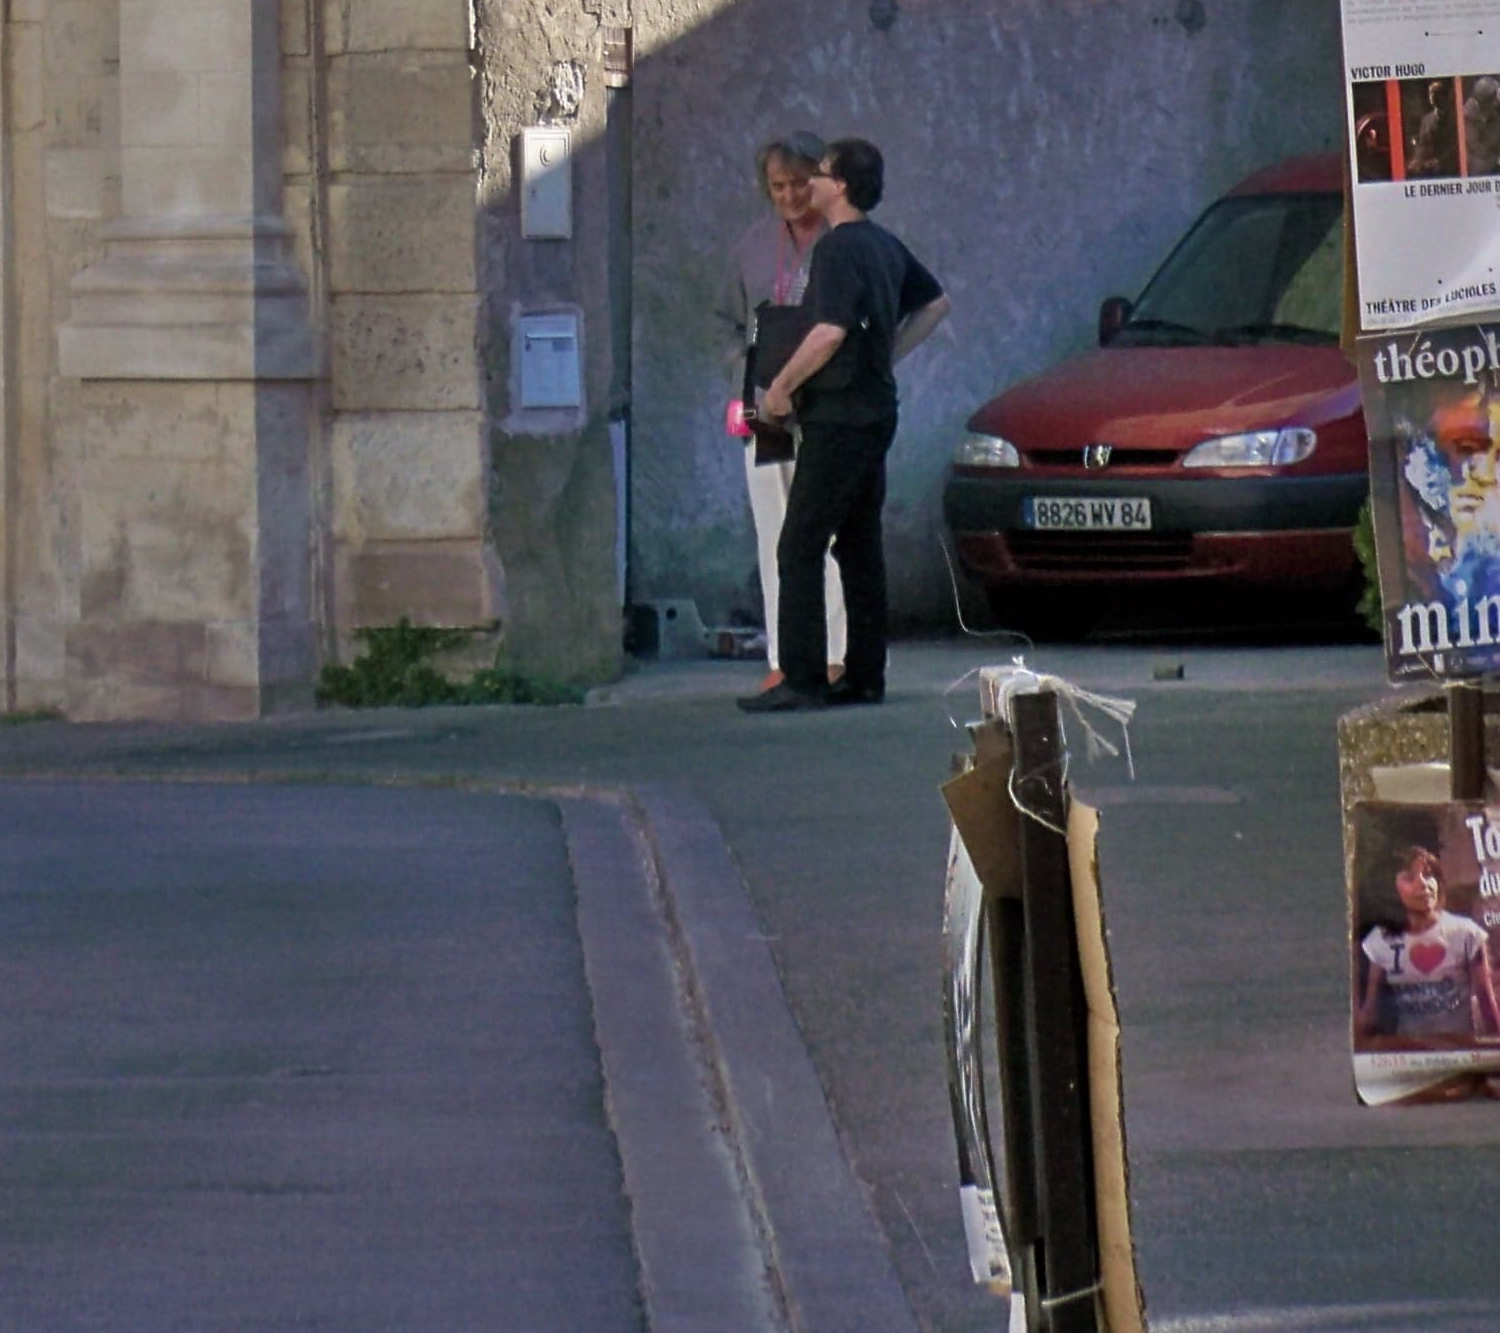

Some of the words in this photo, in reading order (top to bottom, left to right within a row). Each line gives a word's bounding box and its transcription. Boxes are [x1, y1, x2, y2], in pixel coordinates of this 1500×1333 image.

[1350, 64, 1392, 80] VICTOR
[1395, 63, 1426, 77] HUGO
[1404, 185, 1417, 198] LE
[1420, 183, 1463, 197] DERNIER
[1466, 182, 1492, 195] JOUR
[1365, 298, 1417, 314] THÉÂTRE
[1445, 283, 1497, 303] LUCIOLES
[1037, 502, 1087, 527] 8826
[1121, 502, 1147, 527] 84
